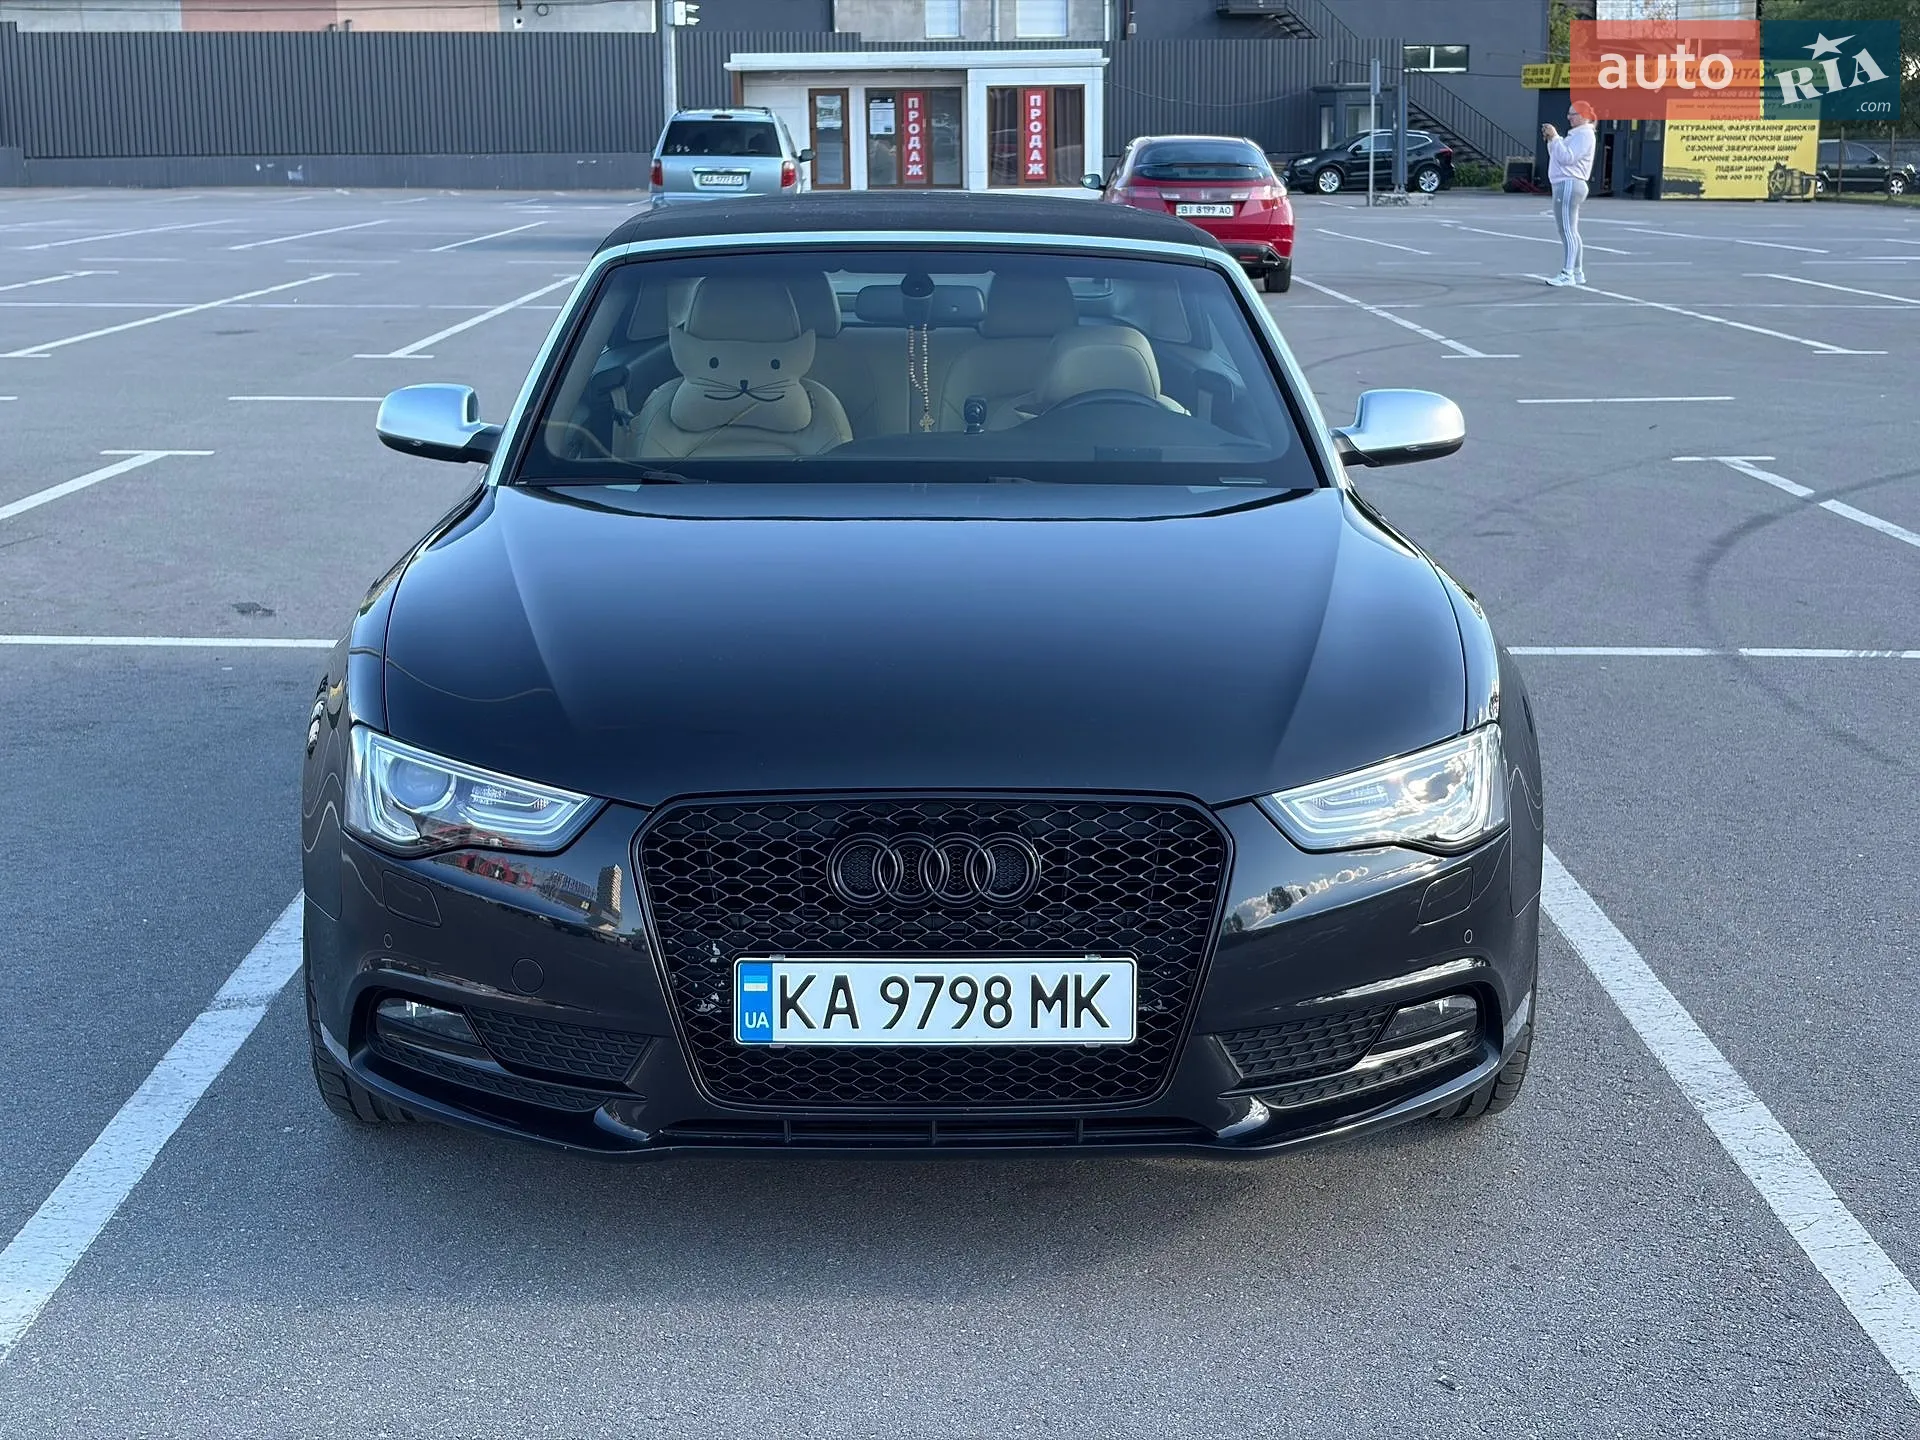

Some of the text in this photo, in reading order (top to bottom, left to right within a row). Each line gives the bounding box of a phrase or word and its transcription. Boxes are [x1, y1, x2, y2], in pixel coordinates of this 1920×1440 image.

[907, 97, 923, 176] ПРОДАЖ
[1027, 95, 1045, 175] ПРОДАЖ
[1727, 124, 1783, 132] ФАРБУВАННЯ
[1784, 124, 1816, 132] ДИСКІВ
[744, 1013, 770, 1029] UA
[779, 974, 1111, 1030] KA 9798 MK
